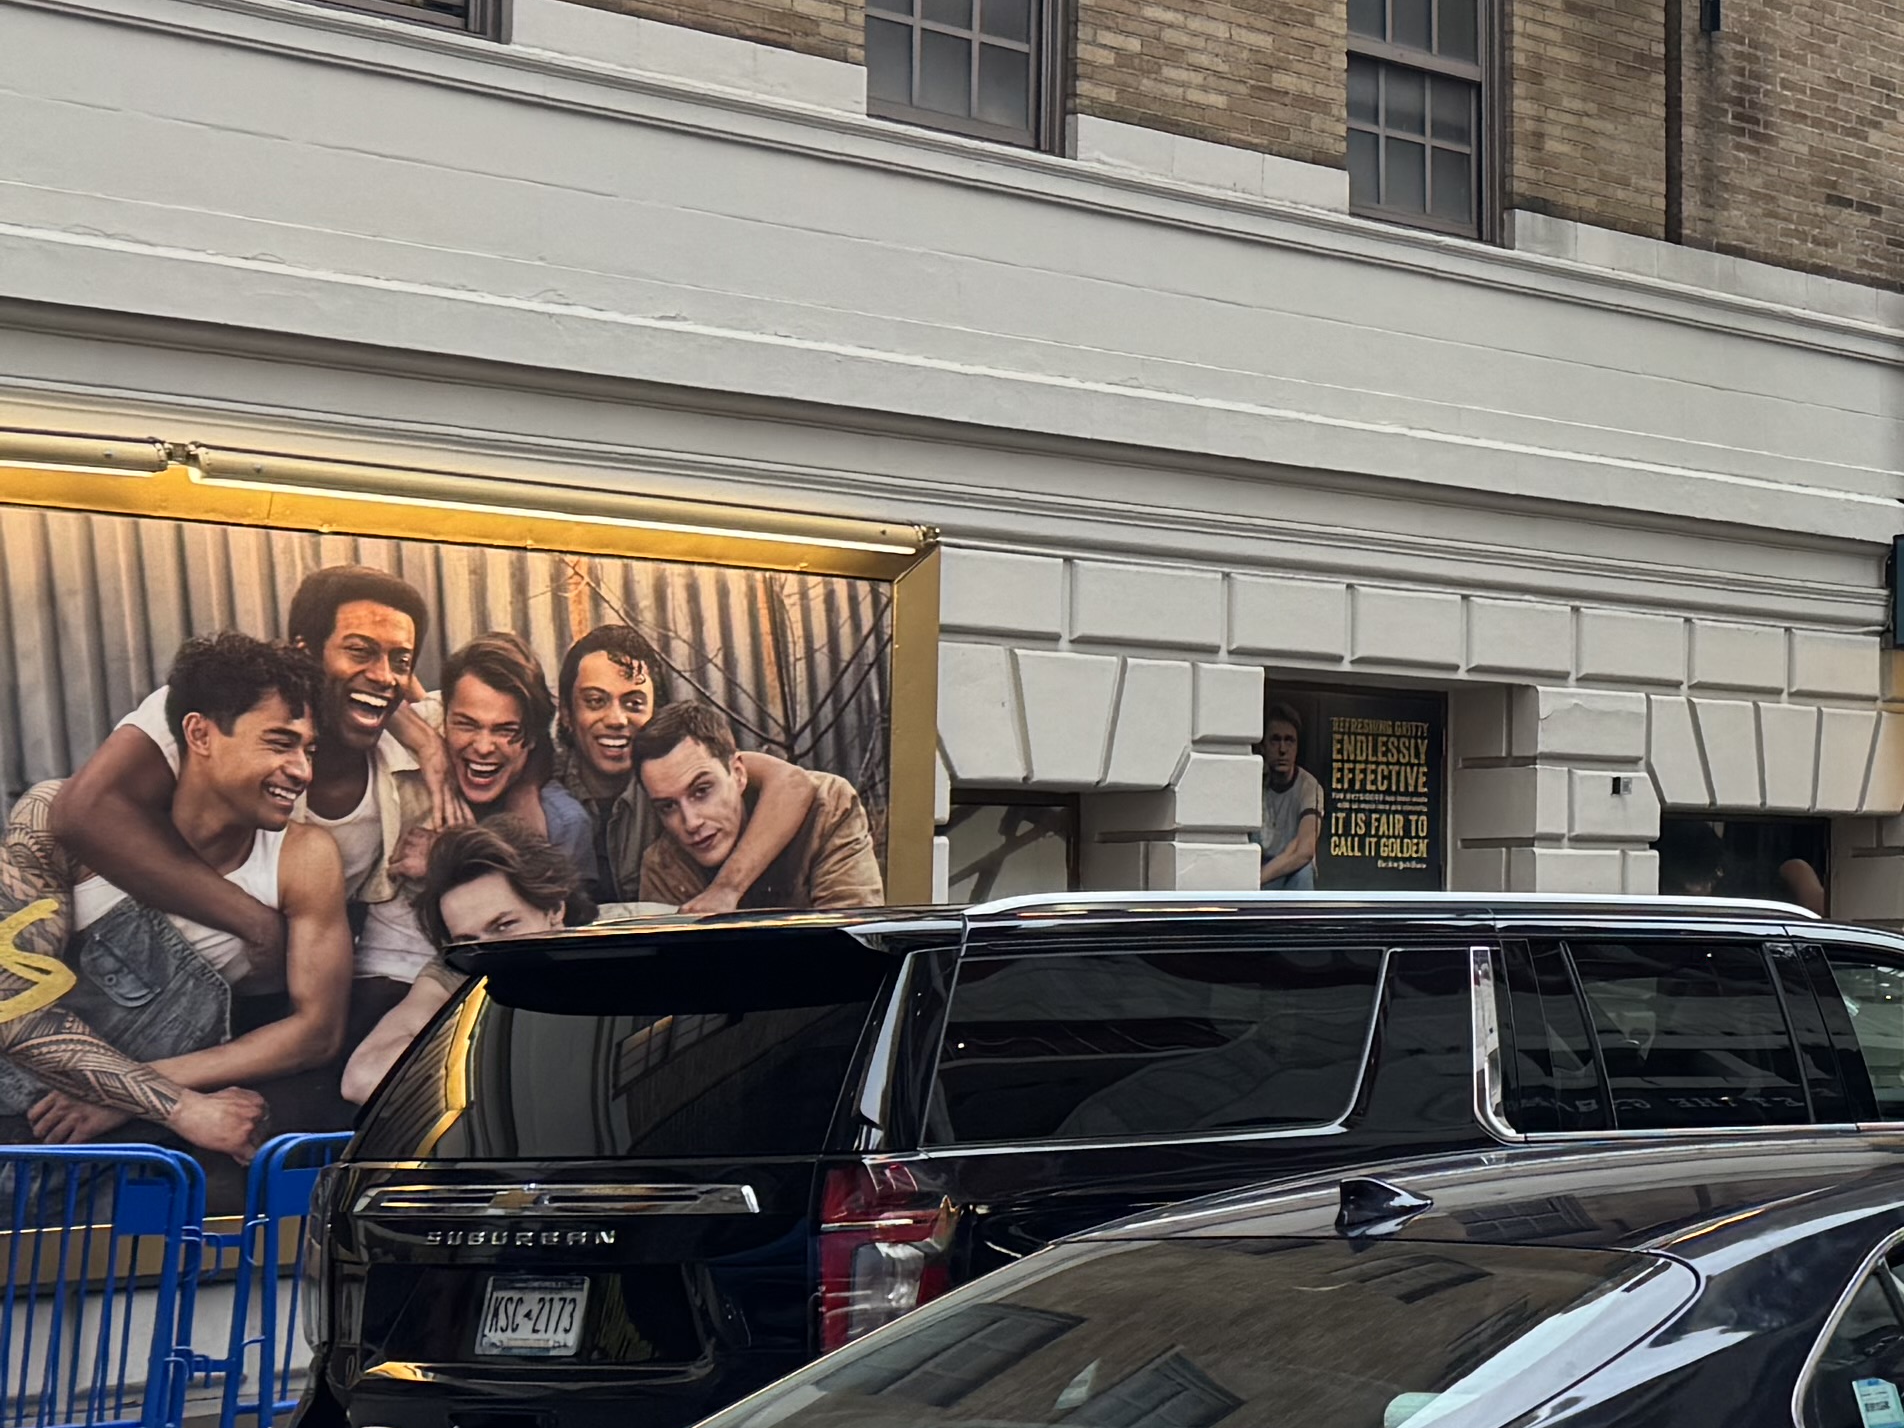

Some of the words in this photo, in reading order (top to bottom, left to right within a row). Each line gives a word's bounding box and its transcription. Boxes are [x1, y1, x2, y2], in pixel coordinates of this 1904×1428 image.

[1332, 733, 1429, 764] ENDLESSLY
[1332, 762, 1429, 793] EFFECTIVE
[1331, 813, 1346, 834] IT
[1351, 813, 1366, 835] IS
[1371, 814, 1404, 837] FAIR
[1409, 815, 1428, 837] TO
[1331, 836, 1362, 856] CALL
[1365, 837, 1378, 857] IT
[426, 1228, 617, 1247] SUBURBAN
